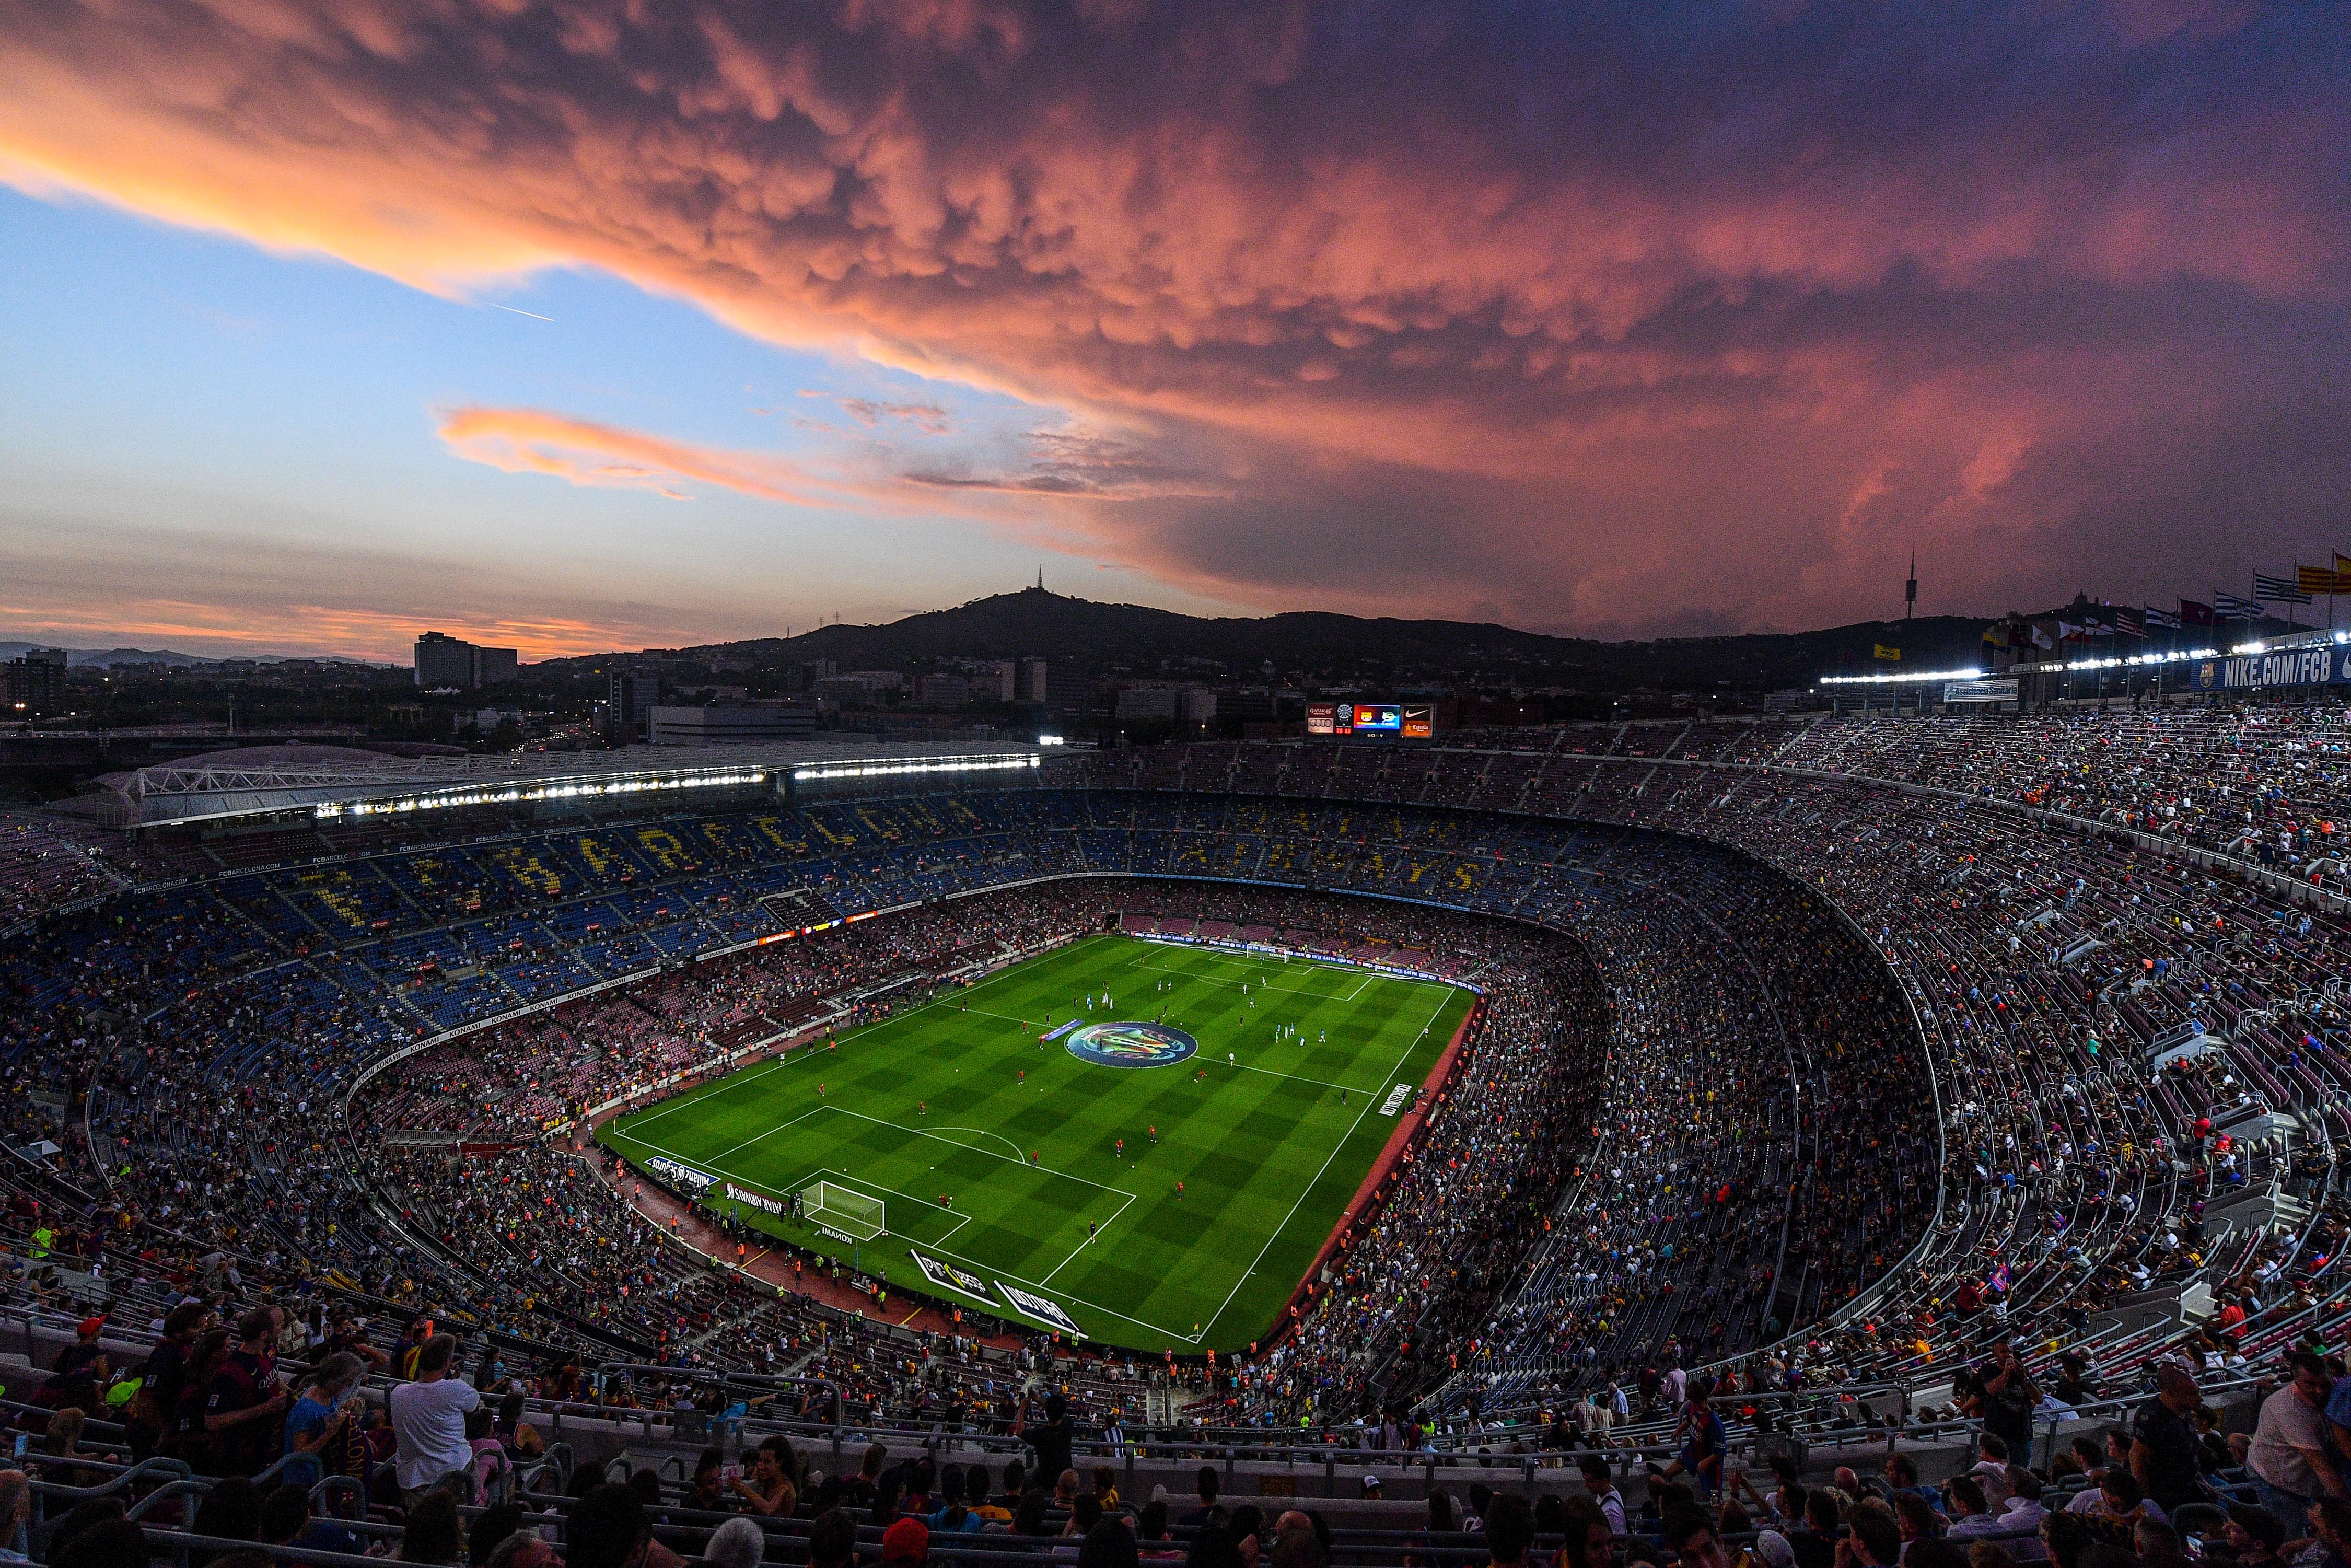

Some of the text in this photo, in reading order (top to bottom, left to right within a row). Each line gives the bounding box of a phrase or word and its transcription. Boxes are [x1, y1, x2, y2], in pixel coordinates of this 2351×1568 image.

[2224, 651, 2331, 687] NIKE.COM/FCB
[400, 841, 450, 852] FCBARCELONA.COM
[313, 851, 370, 863] FCBARCELCOM
[219, 863, 280, 877] FCBARCELONA.COM
[134, 878, 187, 895] FCBARCELONA.COM
[59, 897, 106, 916] FCBARCELONA.COM
[704, 949, 725, 959] KONAMI
[731, 942, 751, 951] KONAMI
[634, 968, 658, 979] KONAMI
[601, 977, 626, 989] KONAMI
[567, 988, 593, 1000] KONAMI
[530, 998, 558, 1012] KONAMI
[491, 1010, 521, 1024] KONAMI
[449, 1023, 480, 1038] KONAMI
[410, 1037, 439, 1053] KONAMI
[376, 1052, 401, 1072] KONAMI
[357, 1068, 375, 1086] KONAMI
[651, 1158, 709, 1188] Allianz Seguros
[735, 1188, 762, 1207] AIRWAYS
[822, 1226, 852, 1244] KONAMI
[1003, 1284, 1080, 1331] beko.com
[258, 1368, 278, 1390] QATA
